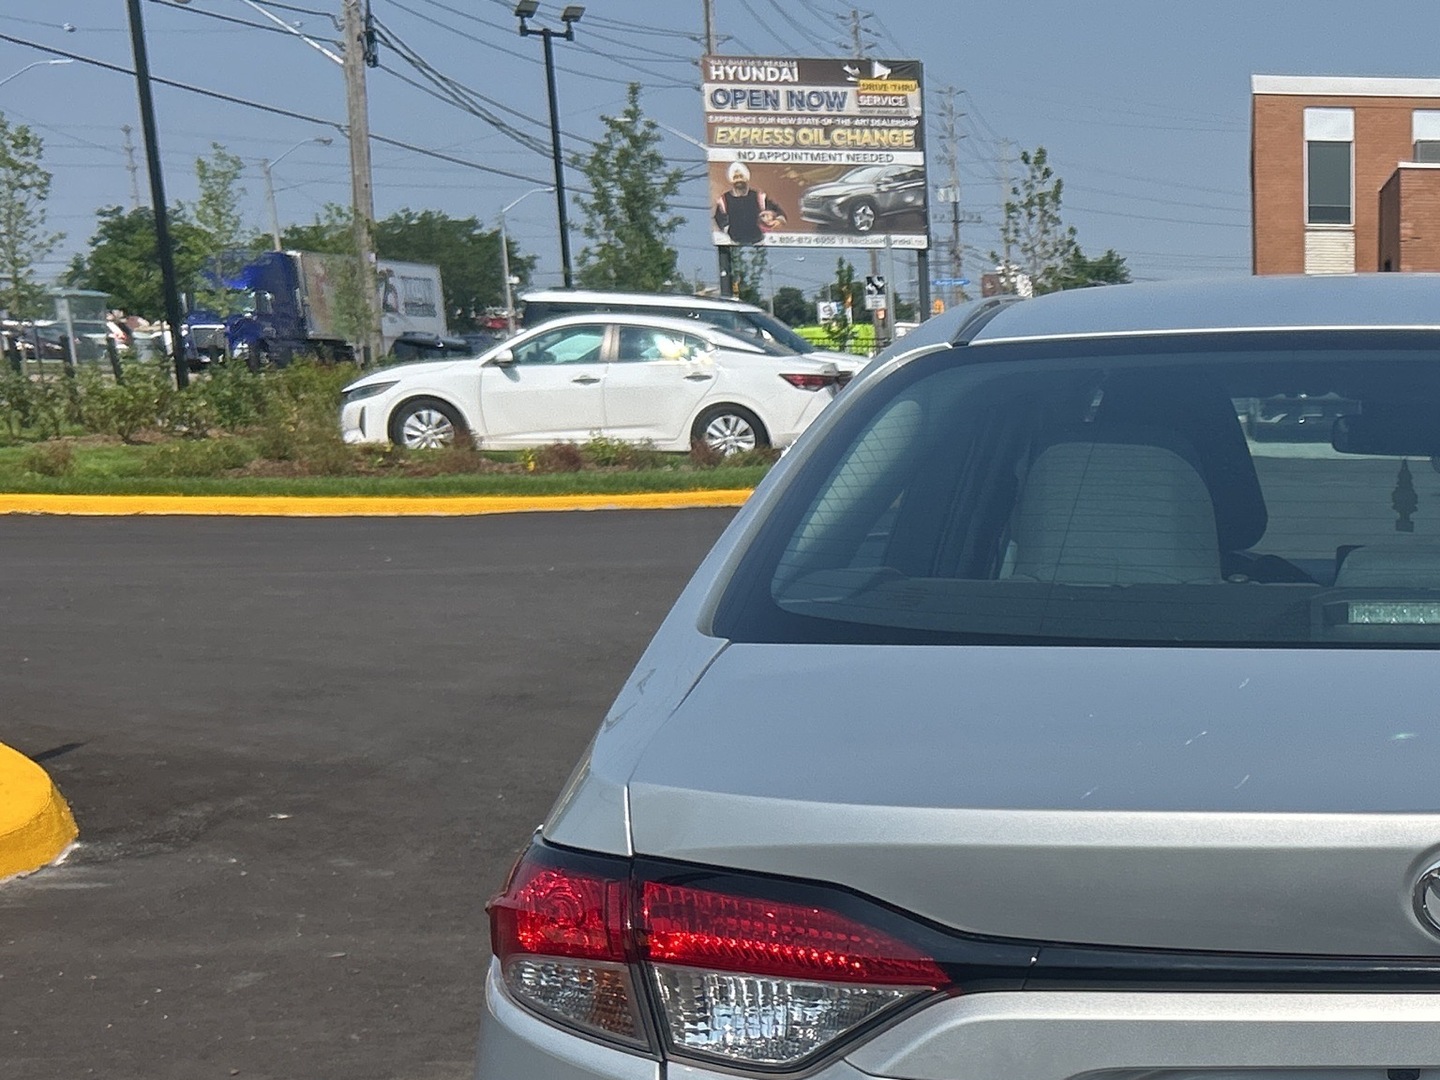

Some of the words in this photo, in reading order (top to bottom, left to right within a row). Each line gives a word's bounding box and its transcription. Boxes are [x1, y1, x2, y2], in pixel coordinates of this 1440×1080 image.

[709, 65, 799, 82] HYUNDAI
[711, 88, 781, 110] OPEN
[786, 90, 849, 112] NOW
[858, 95, 907, 107] SERVICE
[715, 127, 795, 147] EXPRESS
[797, 128, 830, 148] OIL
[831, 128, 916, 149] CHANGE
[738, 151, 755, 160] NO
[758, 151, 843, 162] APPOINTMENT
[846, 153, 895, 162] NEEDED
